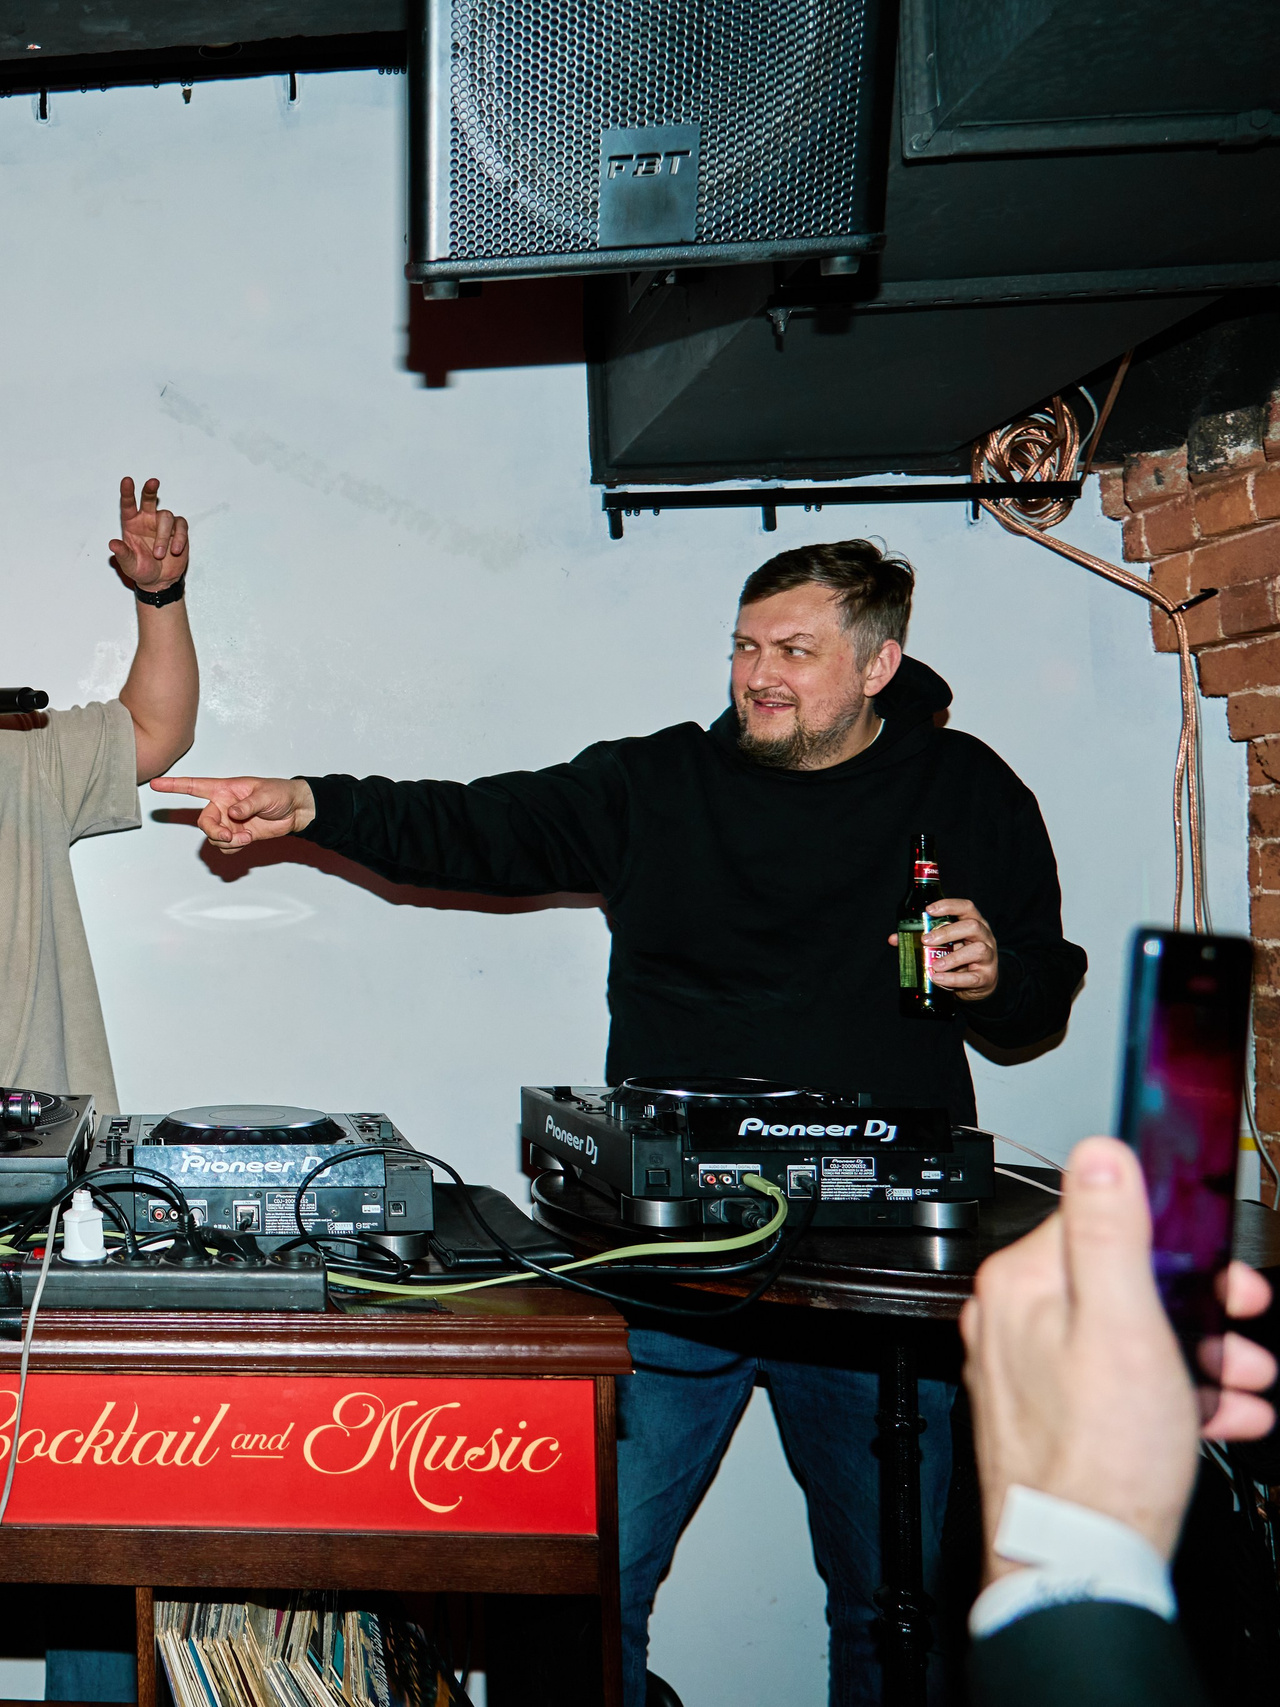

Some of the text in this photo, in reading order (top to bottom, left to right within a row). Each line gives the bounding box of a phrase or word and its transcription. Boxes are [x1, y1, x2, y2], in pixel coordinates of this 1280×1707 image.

[607, 150, 691, 179] FBT
[545, 1114, 584, 1151] Pioneer
[738, 1117, 858, 1137] Pioneer
[181, 1154, 295, 1173] Pioneer
[231, 1422, 294, 1451] and
[303, 1391, 563, 1514] Music
